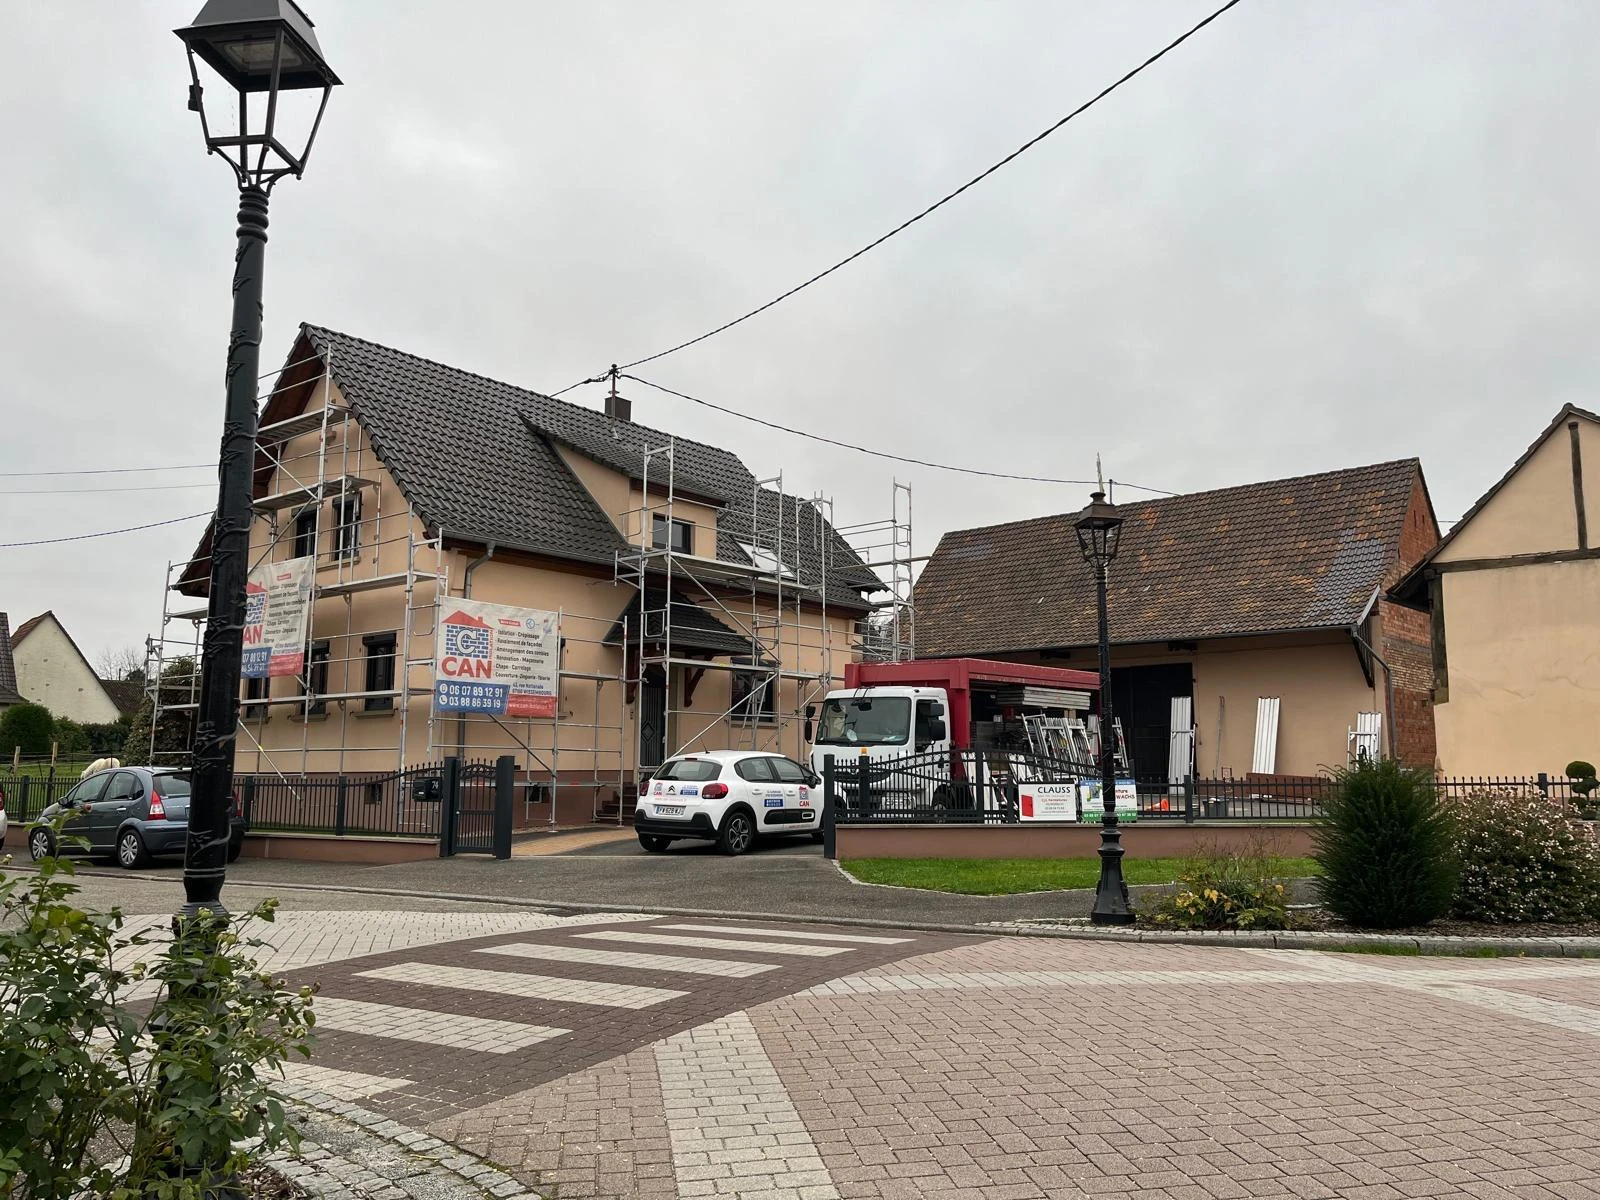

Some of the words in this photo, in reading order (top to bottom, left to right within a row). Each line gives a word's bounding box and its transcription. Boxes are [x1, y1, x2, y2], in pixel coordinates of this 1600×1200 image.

[242, 624, 263, 644] AN
[441, 656, 492, 678] CAN
[450, 684, 460, 695] 06
[461, 686, 471, 696] 07
[473, 686, 483, 696] 89
[485, 687, 493, 697] 12
[495, 688, 503, 698] 91
[449, 696, 459, 706] 03
[460, 697, 470, 707] 88
[472, 698, 482, 707] 86
[482, 698, 492, 708] 39
[493, 699, 501, 708] 19
